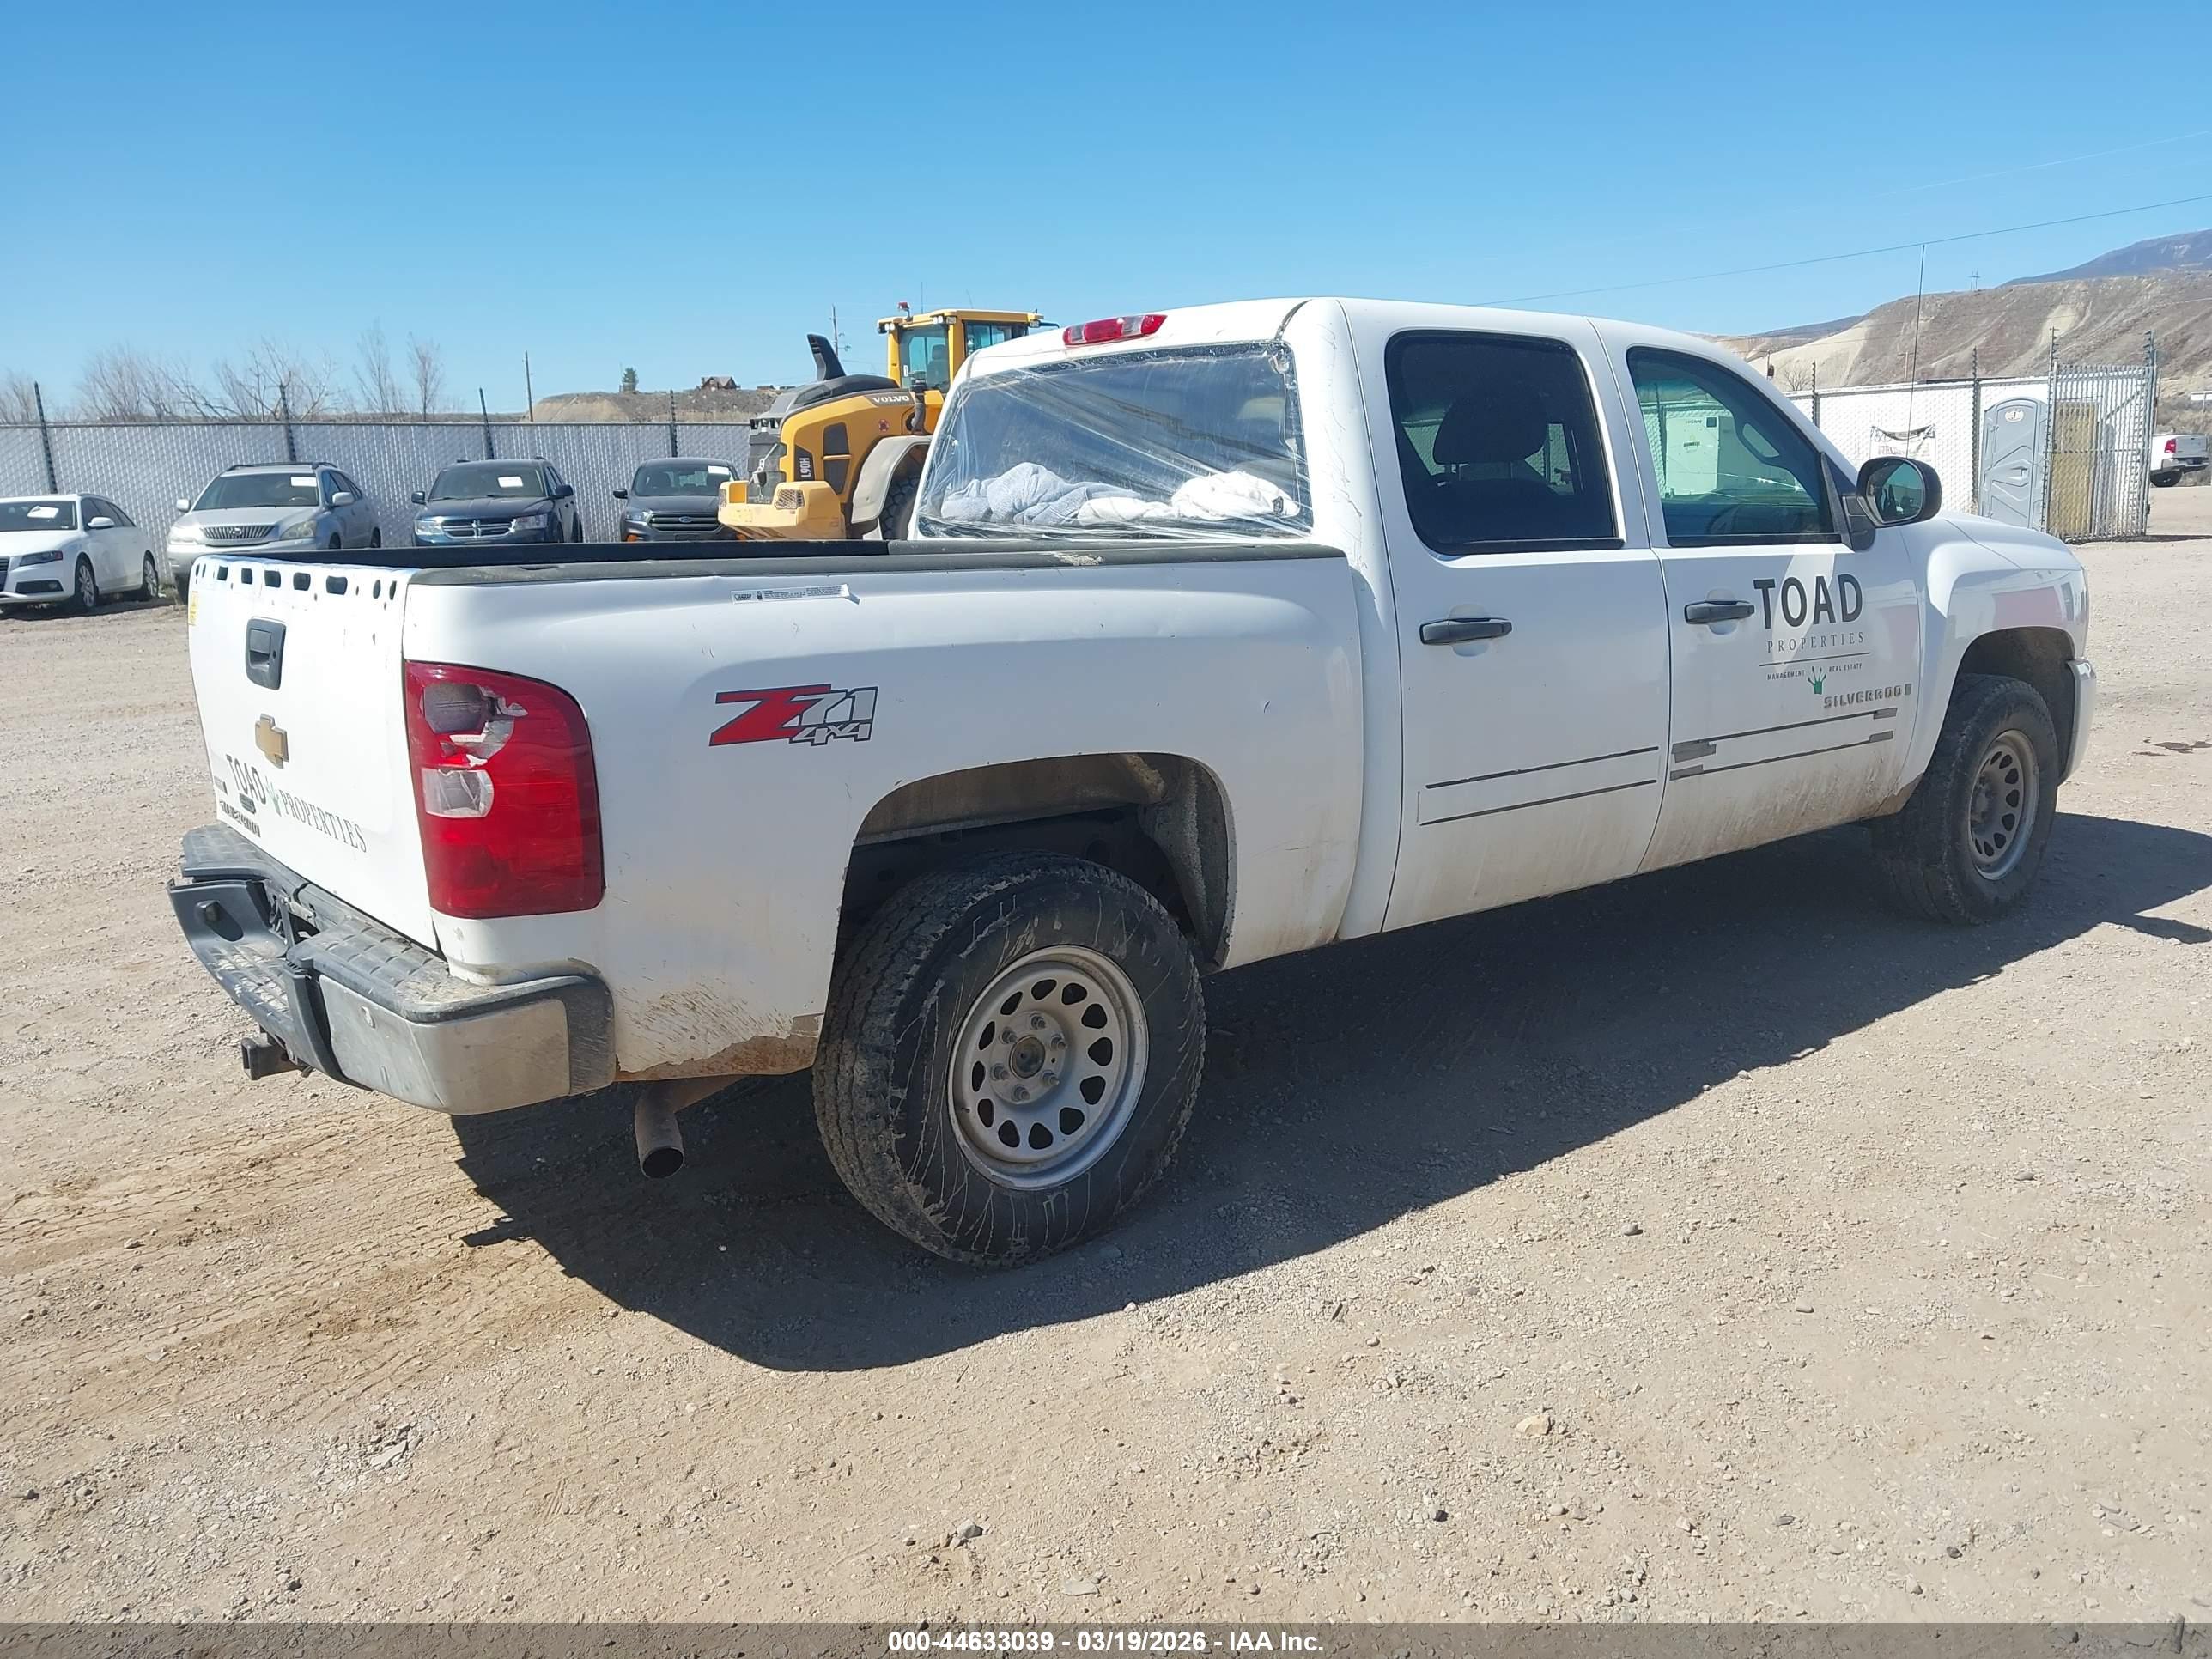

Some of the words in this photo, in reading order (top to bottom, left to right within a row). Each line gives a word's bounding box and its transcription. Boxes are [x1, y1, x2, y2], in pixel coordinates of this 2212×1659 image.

[872, 395, 910, 404] VOLVO
[799, 457, 812, 478] L90H
[1753, 574, 1863, 629] TOAD
[1767, 632, 1864, 653] PROPERTIES
[1767, 670, 1805, 680] MANAGEMENT
[1844, 663, 1863, 672] ESTATE
[1823, 684, 1903, 708] SILVERADO
[708, 684, 878, 747] Z71
[225, 753, 267, 805] TOAD
[278, 789, 368, 854] PROPERTIES
